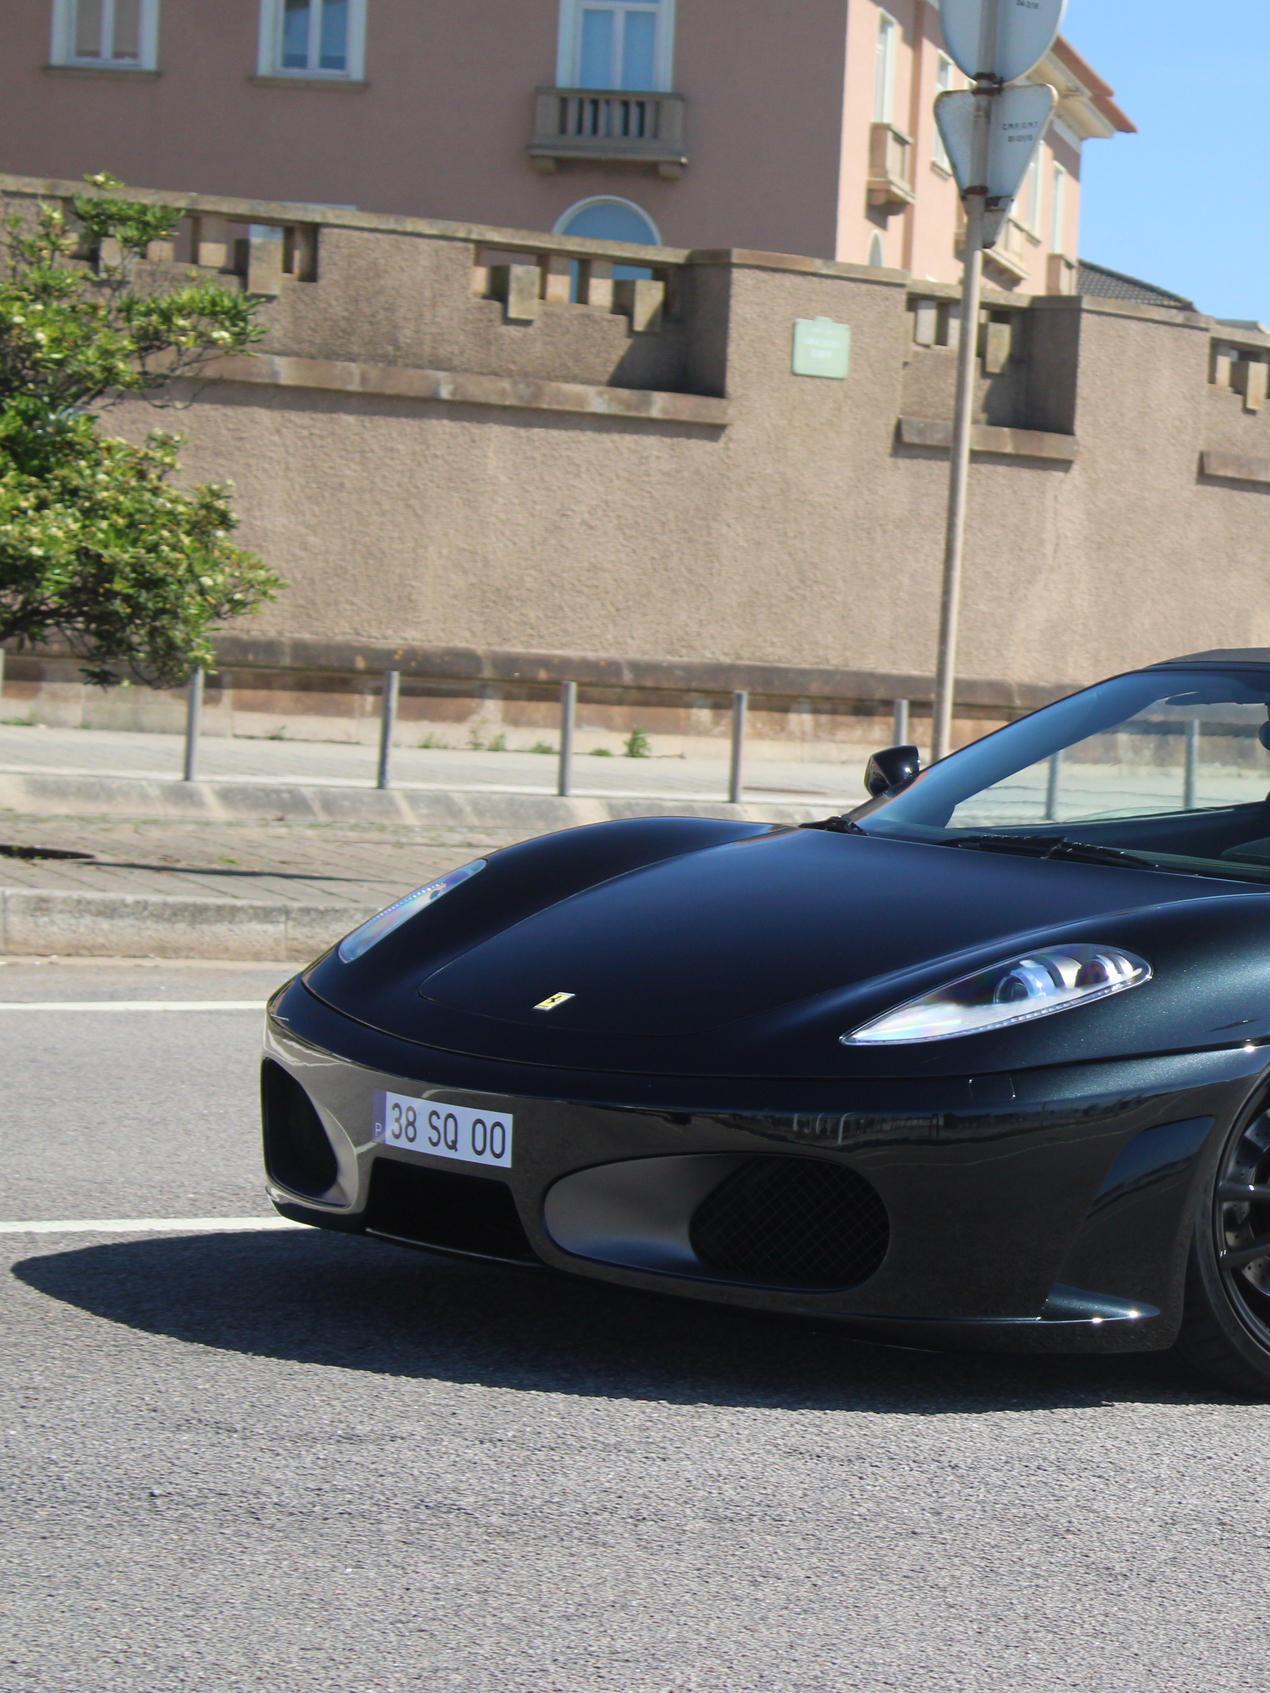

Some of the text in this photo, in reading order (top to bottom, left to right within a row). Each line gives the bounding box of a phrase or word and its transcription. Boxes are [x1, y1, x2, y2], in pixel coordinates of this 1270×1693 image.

[374, 1122, 382, 1136] P
[391, 1102, 506, 1160] 38 SQ 00
